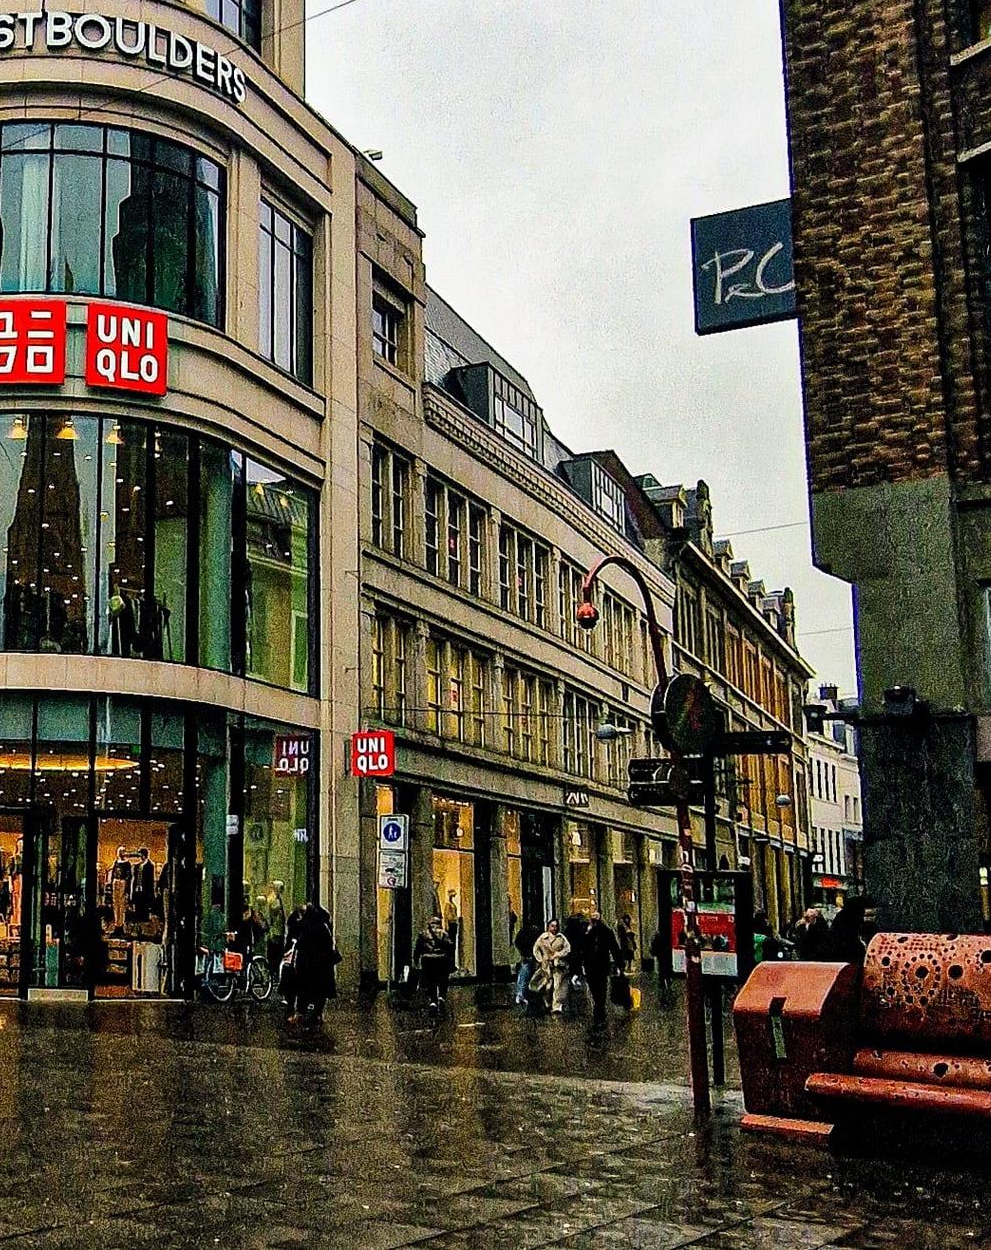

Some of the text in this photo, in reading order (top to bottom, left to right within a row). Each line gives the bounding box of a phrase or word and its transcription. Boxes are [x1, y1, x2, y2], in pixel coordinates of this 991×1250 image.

[97, 314, 154, 349] UNI
[96, 348, 158, 383] QLO
[357, 737, 385, 753] UNI
[357, 753, 388, 773] QLO
